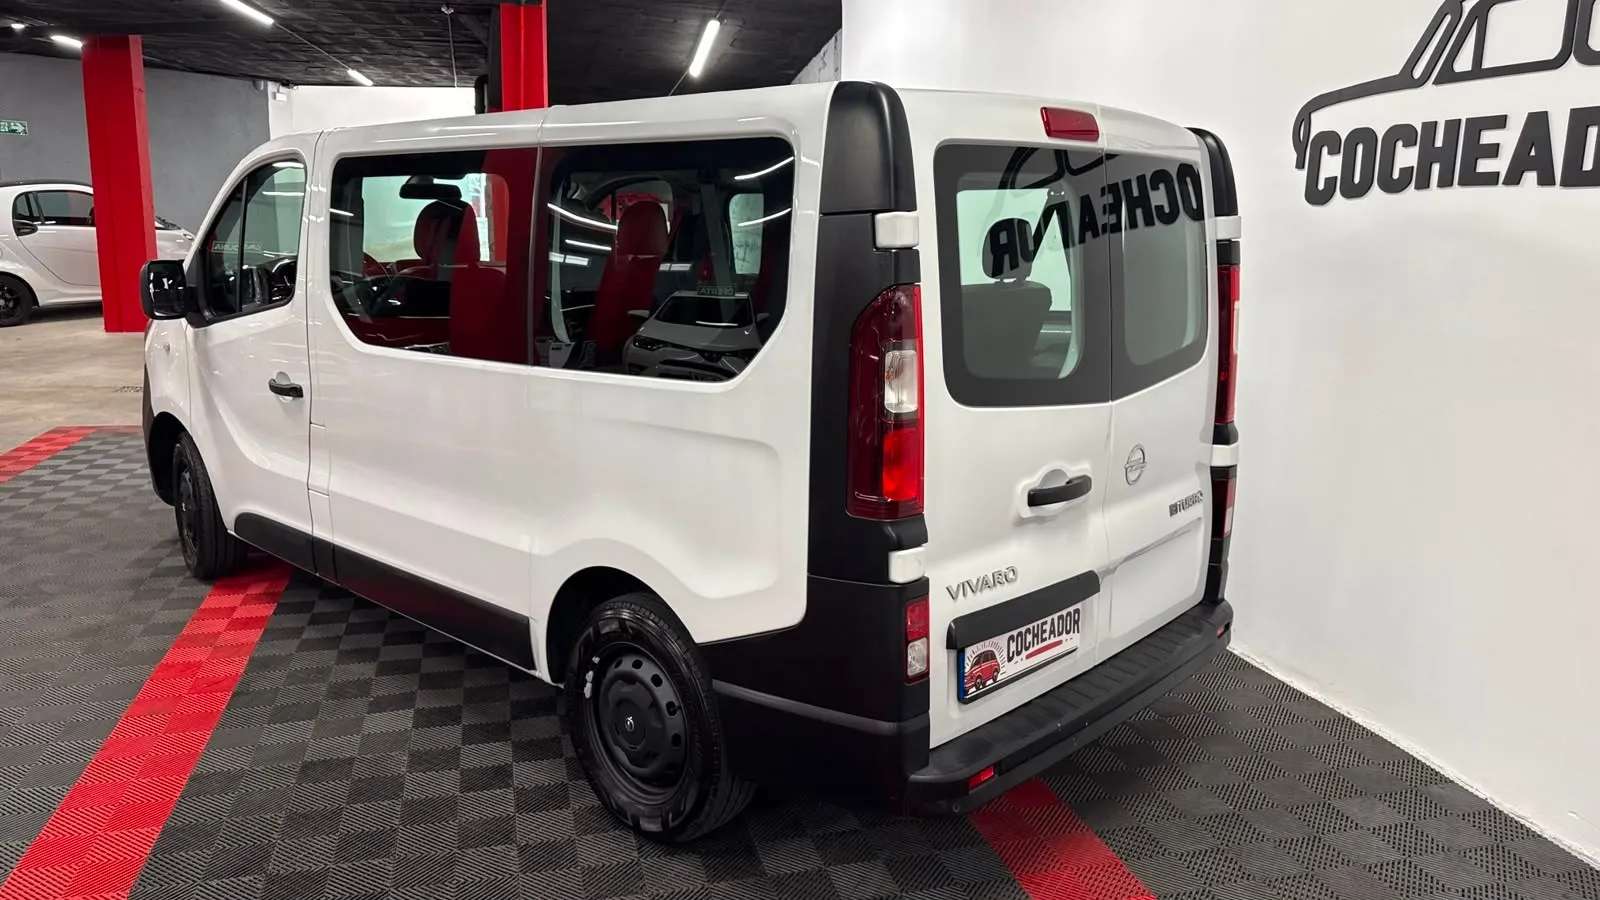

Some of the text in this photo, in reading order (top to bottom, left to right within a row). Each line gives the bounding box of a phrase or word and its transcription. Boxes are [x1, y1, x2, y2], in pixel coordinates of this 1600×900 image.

[1304, 105, 1600, 206] COCHEAD
[946, 566, 1018, 601] VIVARO
[1006, 607, 1081, 663] COCHEADOR
